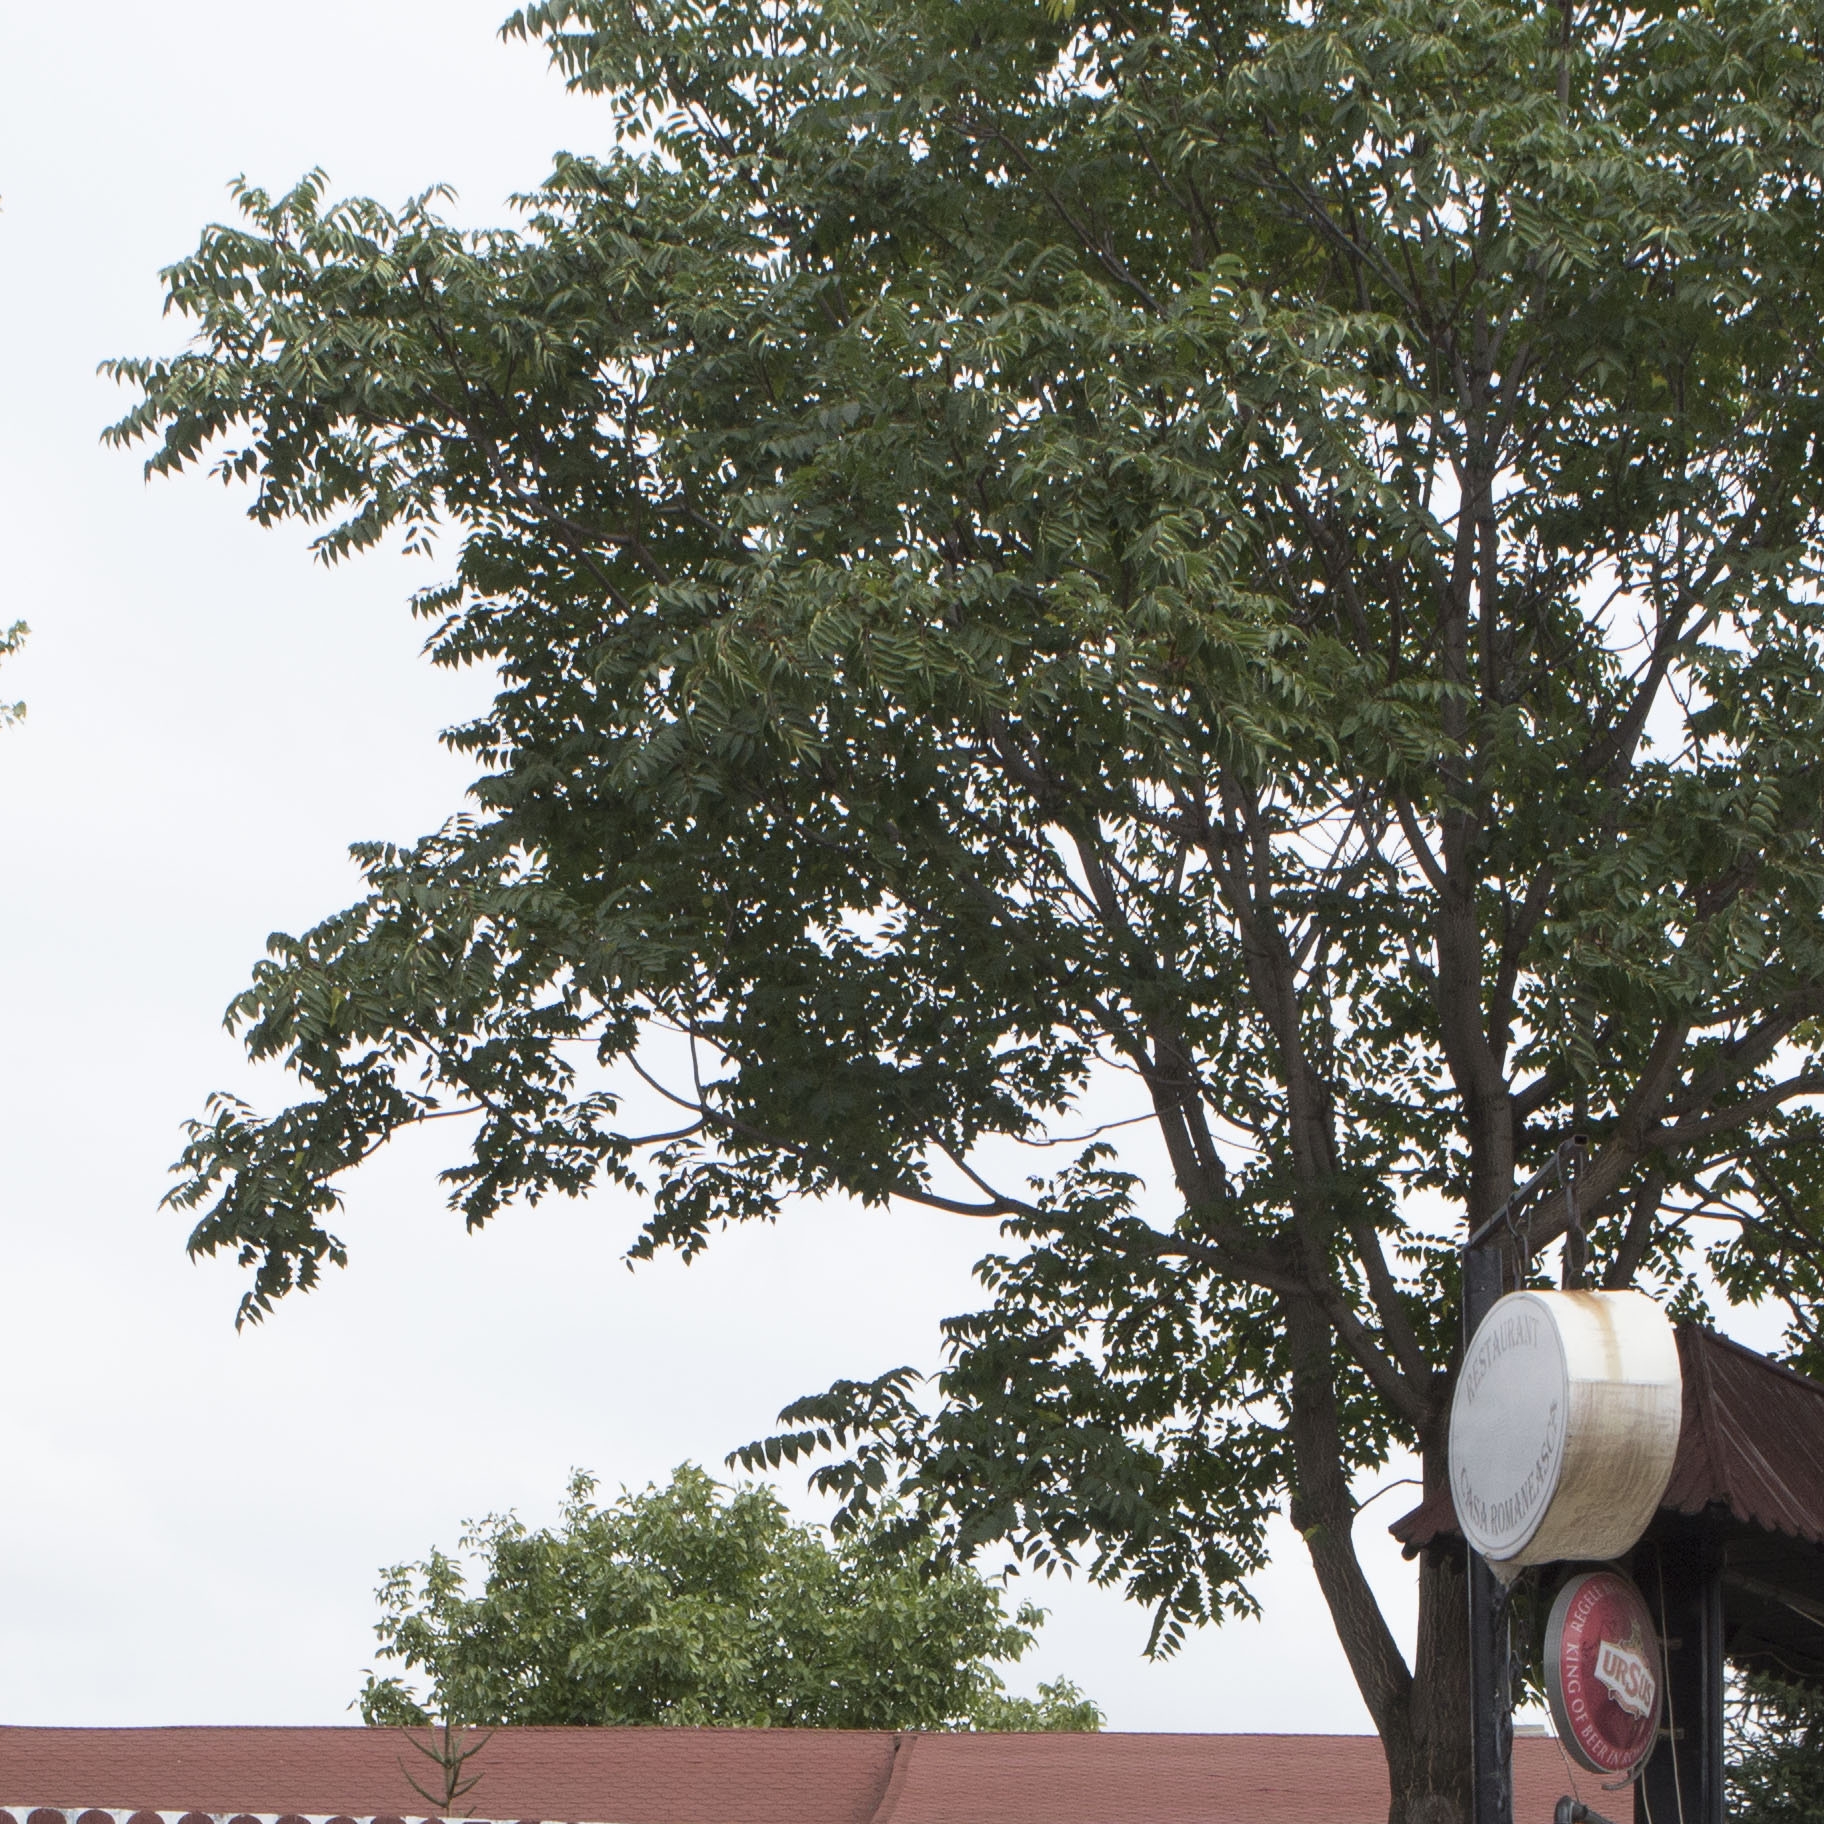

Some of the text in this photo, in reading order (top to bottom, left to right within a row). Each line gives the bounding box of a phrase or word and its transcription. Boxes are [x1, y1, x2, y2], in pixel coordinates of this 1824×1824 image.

[1466, 1315, 1539, 1405] RESTAURANT
[1460, 1401, 1558, 1536] CASA ROMANEASCA
[1566, 1642, 1621, 1766] KING OF BEER IN
[1602, 1649, 1655, 1708] URSUS
